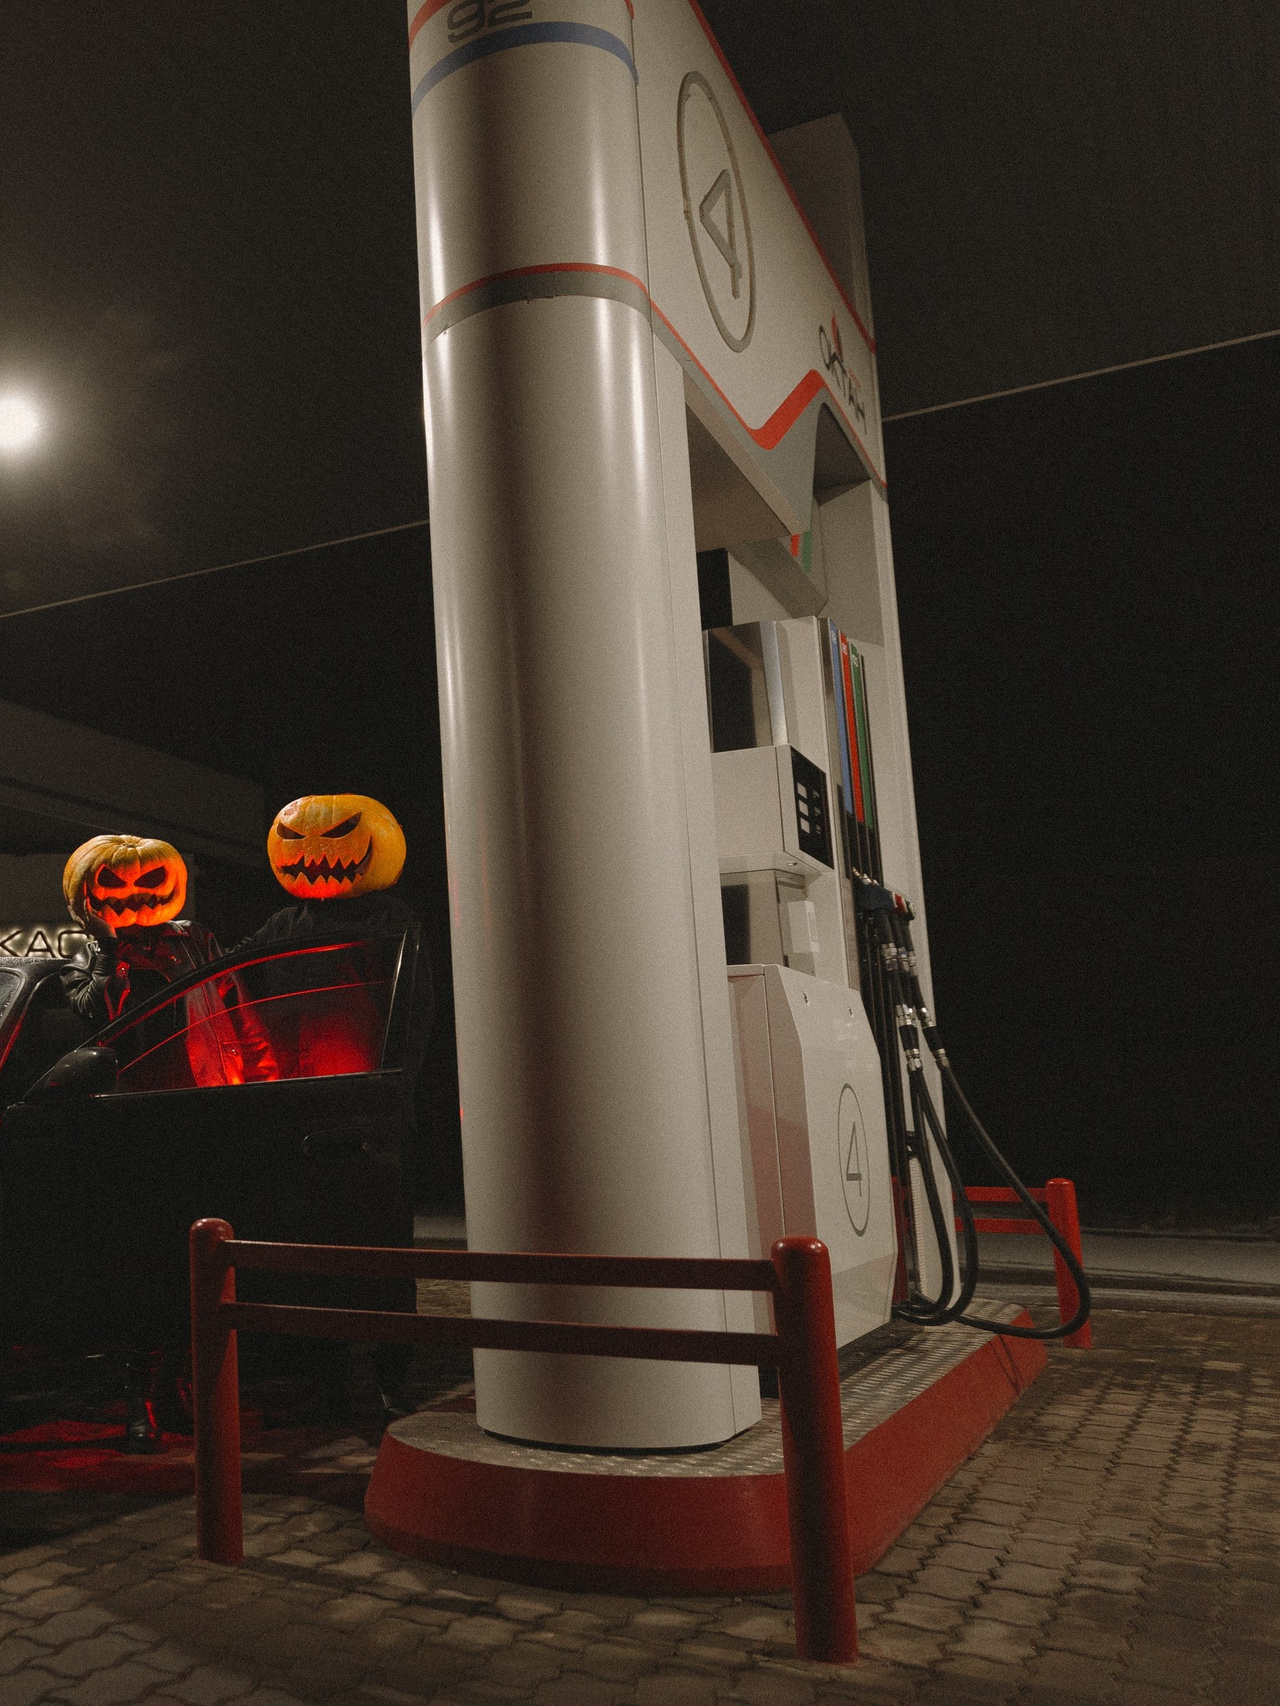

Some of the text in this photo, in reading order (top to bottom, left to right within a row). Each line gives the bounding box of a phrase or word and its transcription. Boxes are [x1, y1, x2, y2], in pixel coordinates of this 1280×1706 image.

[447, 0, 533, 43] 92
[698, 168, 742, 299] 4
[846, 1121, 862, 1197] 4
